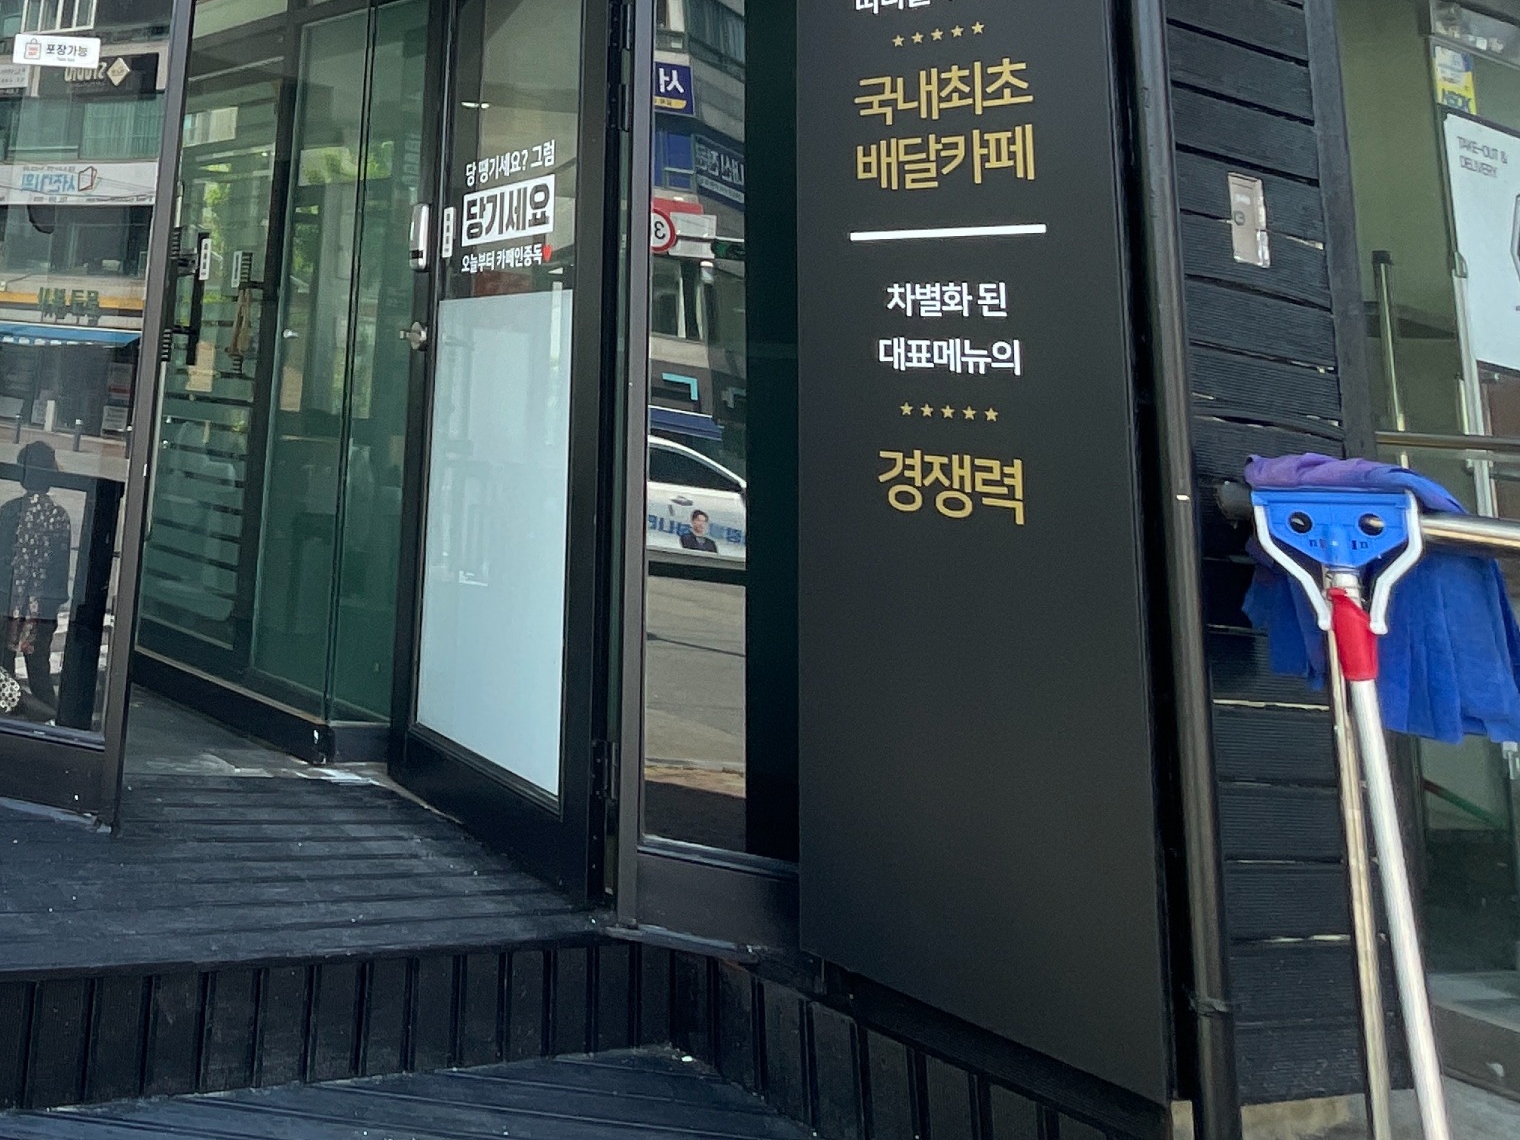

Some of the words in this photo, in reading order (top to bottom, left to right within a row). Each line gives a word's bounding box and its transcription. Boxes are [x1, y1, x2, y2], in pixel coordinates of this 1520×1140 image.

[854, 57, 1034, 126] 국내최초
[530, 139, 556, 168] 그럼
[855, 123, 1036, 191] 배달카페
[466, 182, 550, 240] 당기세요
[461, 250, 495, 275] 오늘부터
[496, 243, 543, 270] 카페인중독
[885, 281, 973, 318] 차별화
[977, 281, 1008, 318] 된
[878, 336, 1022, 377] 대표메뉴의
[878, 449, 1025, 526] 경쟁력
